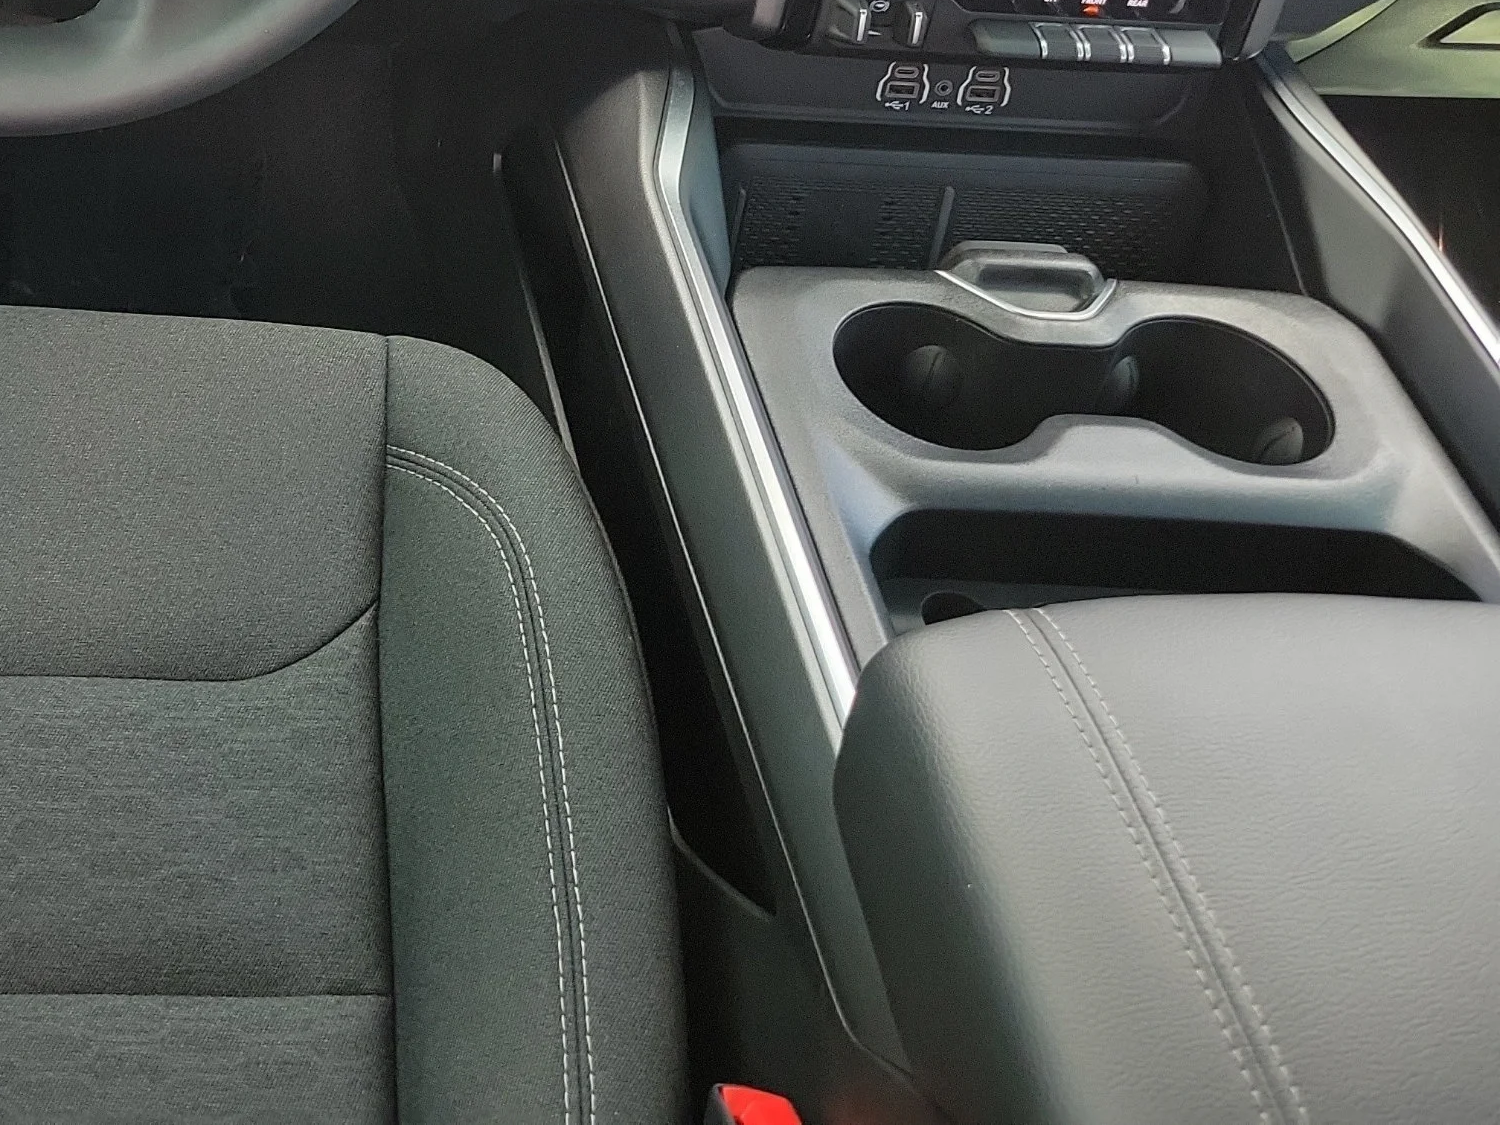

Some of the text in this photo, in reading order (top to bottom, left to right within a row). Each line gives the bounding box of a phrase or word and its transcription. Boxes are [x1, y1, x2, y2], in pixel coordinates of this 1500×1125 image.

[1127, 0, 1149, 7] REAR
[931, 101, 949, 109] AUX
[985, 106, 993, 114] 2
